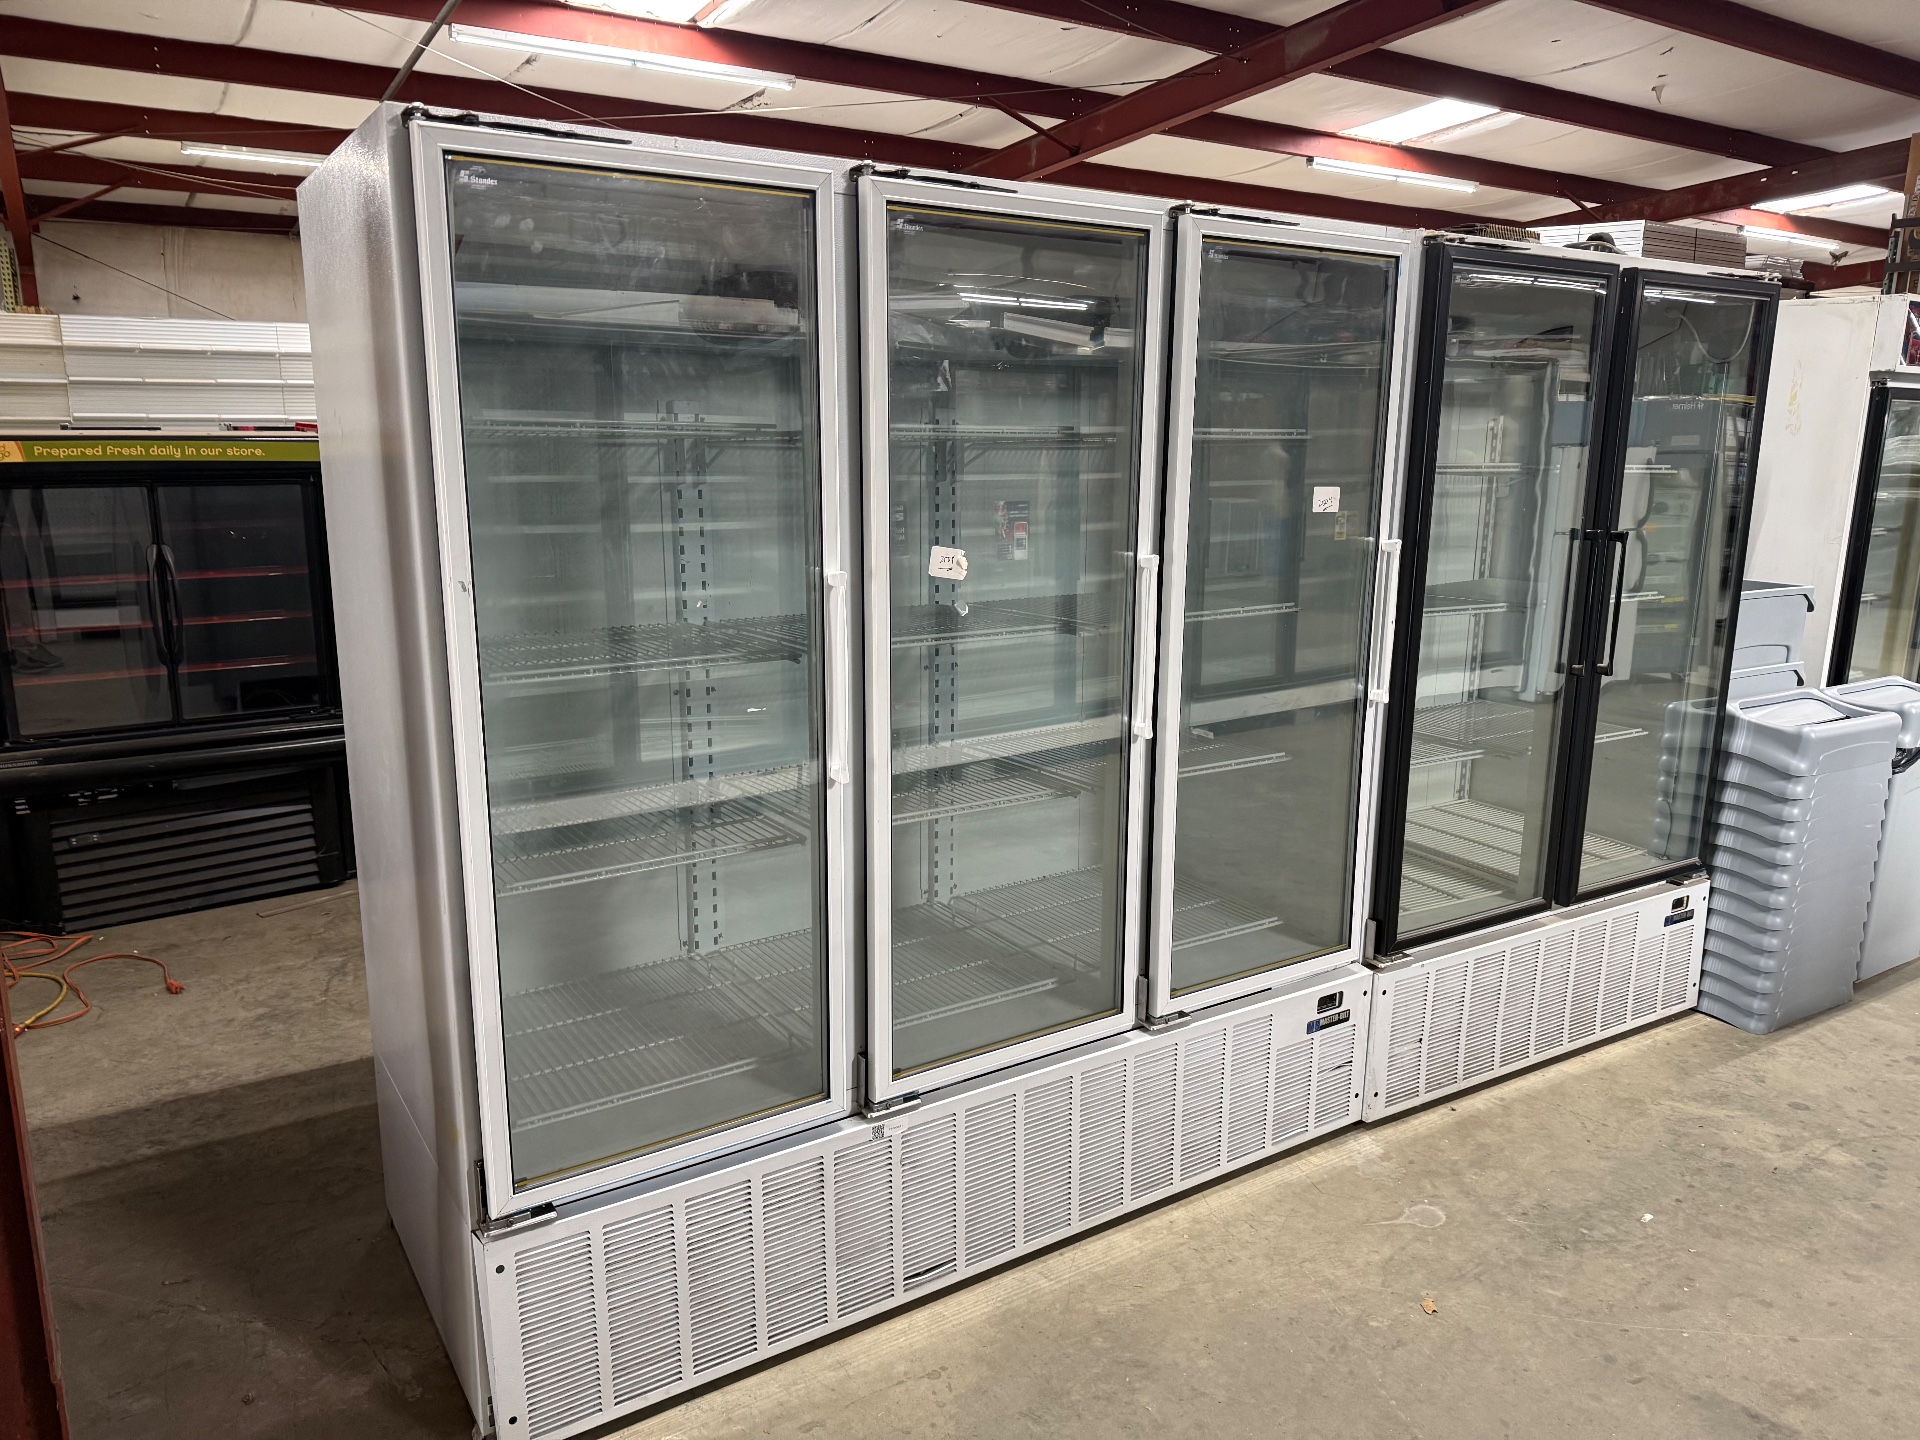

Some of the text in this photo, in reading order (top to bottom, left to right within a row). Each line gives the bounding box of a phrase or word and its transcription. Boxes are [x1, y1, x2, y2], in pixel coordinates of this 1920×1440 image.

[33, 445, 102, 458] Prepared
[149, 445, 181, 458] daily
[185, 445, 196, 456] in
[200, 447, 223, 456] our
[226, 446, 266, 456] store.
